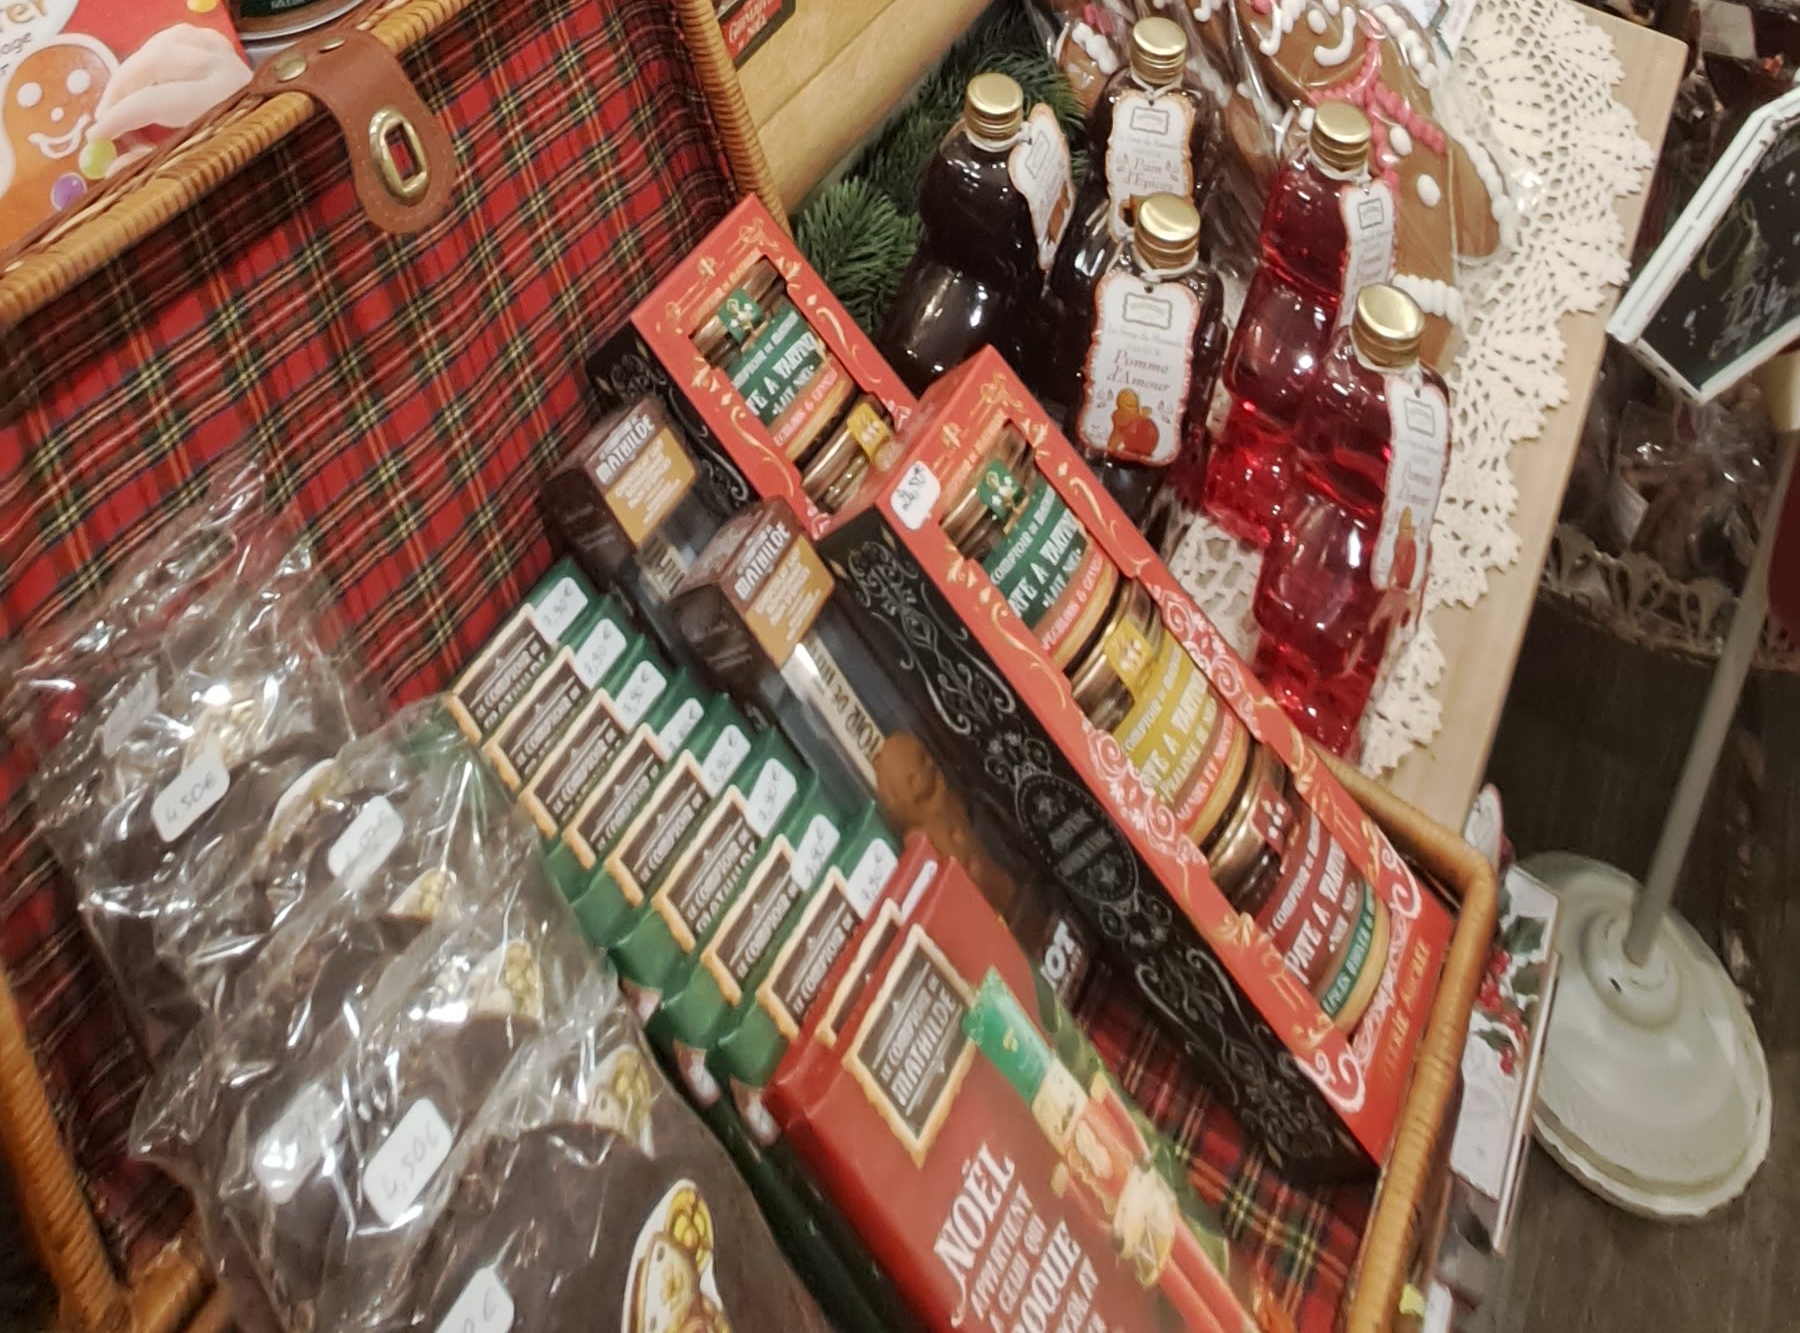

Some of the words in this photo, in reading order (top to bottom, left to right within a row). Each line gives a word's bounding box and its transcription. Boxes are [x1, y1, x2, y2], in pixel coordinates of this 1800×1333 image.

[594, 413, 656, 485] MATHILDE
[733, 520, 791, 601] MATHILDE
[1030, 562, 1049, 584] A
[887, 985, 932, 1067] COMPTOIR
[890, 984, 957, 1107] MATHILDE
[933, 1141, 1016, 1329] NOËL
[970, 1181, 1033, 1322] APPARTIENT
